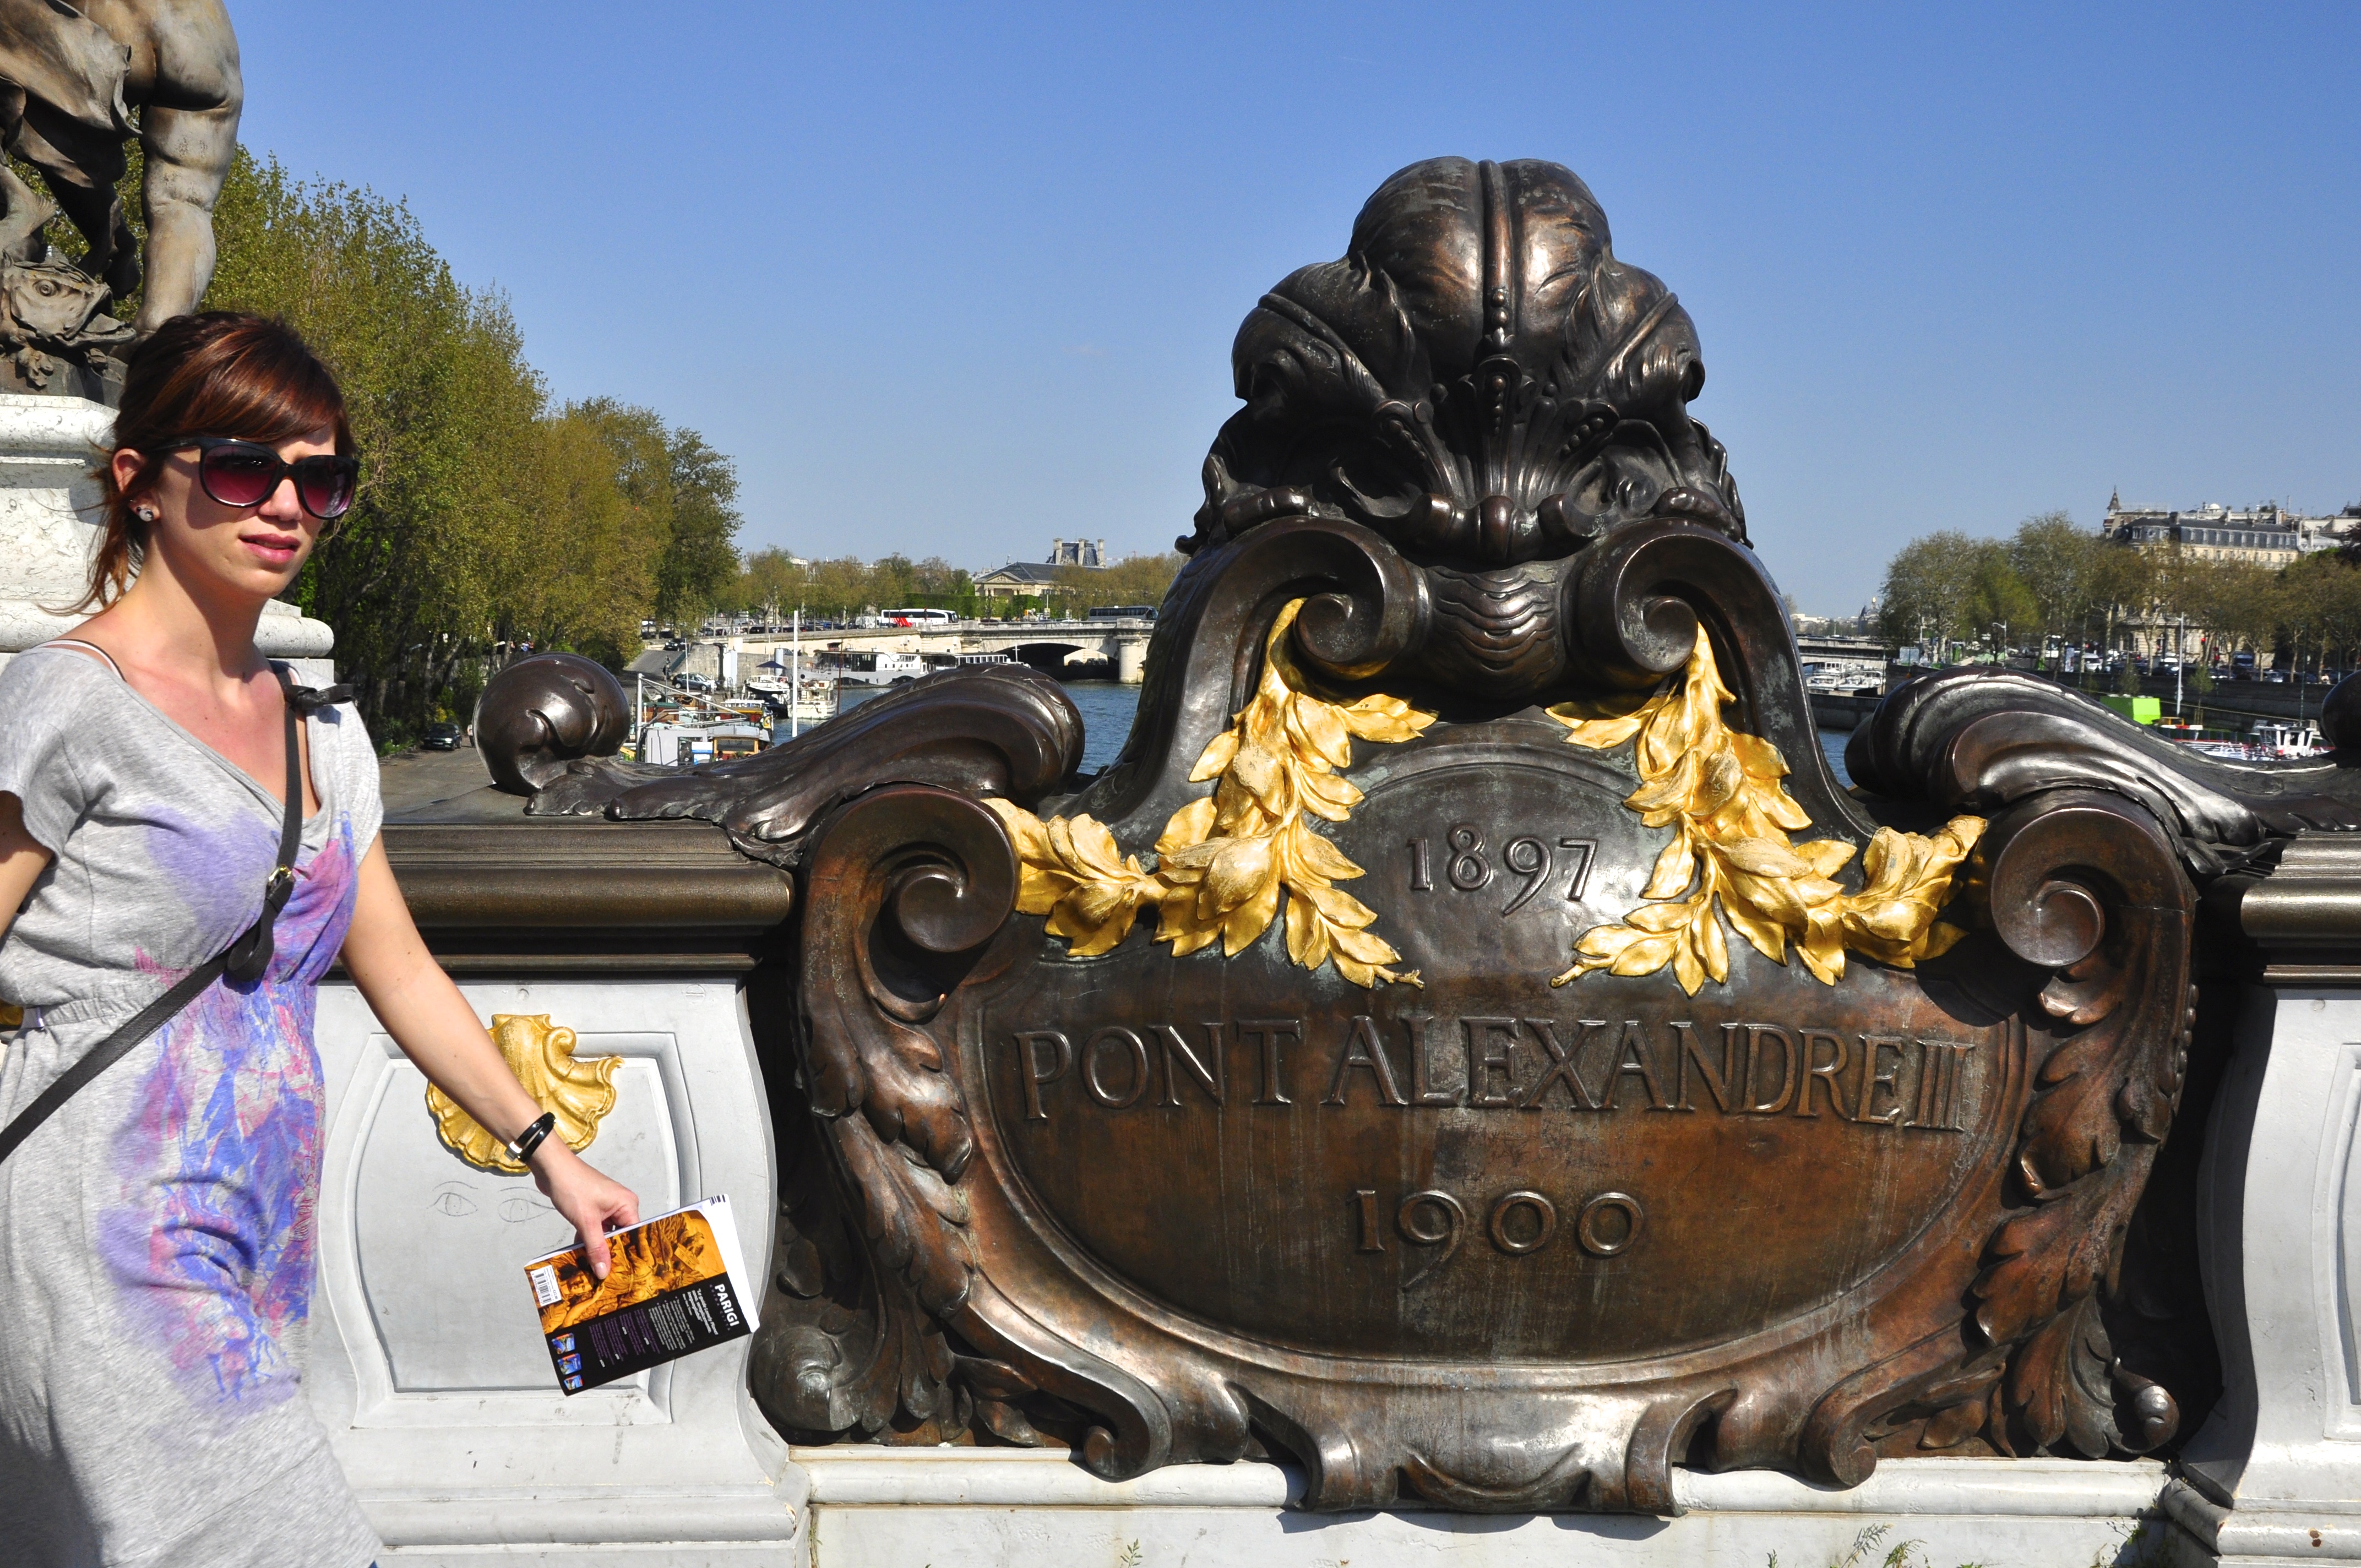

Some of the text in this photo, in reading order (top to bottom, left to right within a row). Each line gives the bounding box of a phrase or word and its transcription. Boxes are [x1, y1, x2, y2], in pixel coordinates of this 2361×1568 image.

[1406, 825, 1598, 917] 1897
[1013, 1015, 1976, 1133] PONT ALEXANDRE III
[1347, 1188, 1644, 1290] 1900
[715, 1284, 739, 1326] PARIGI
